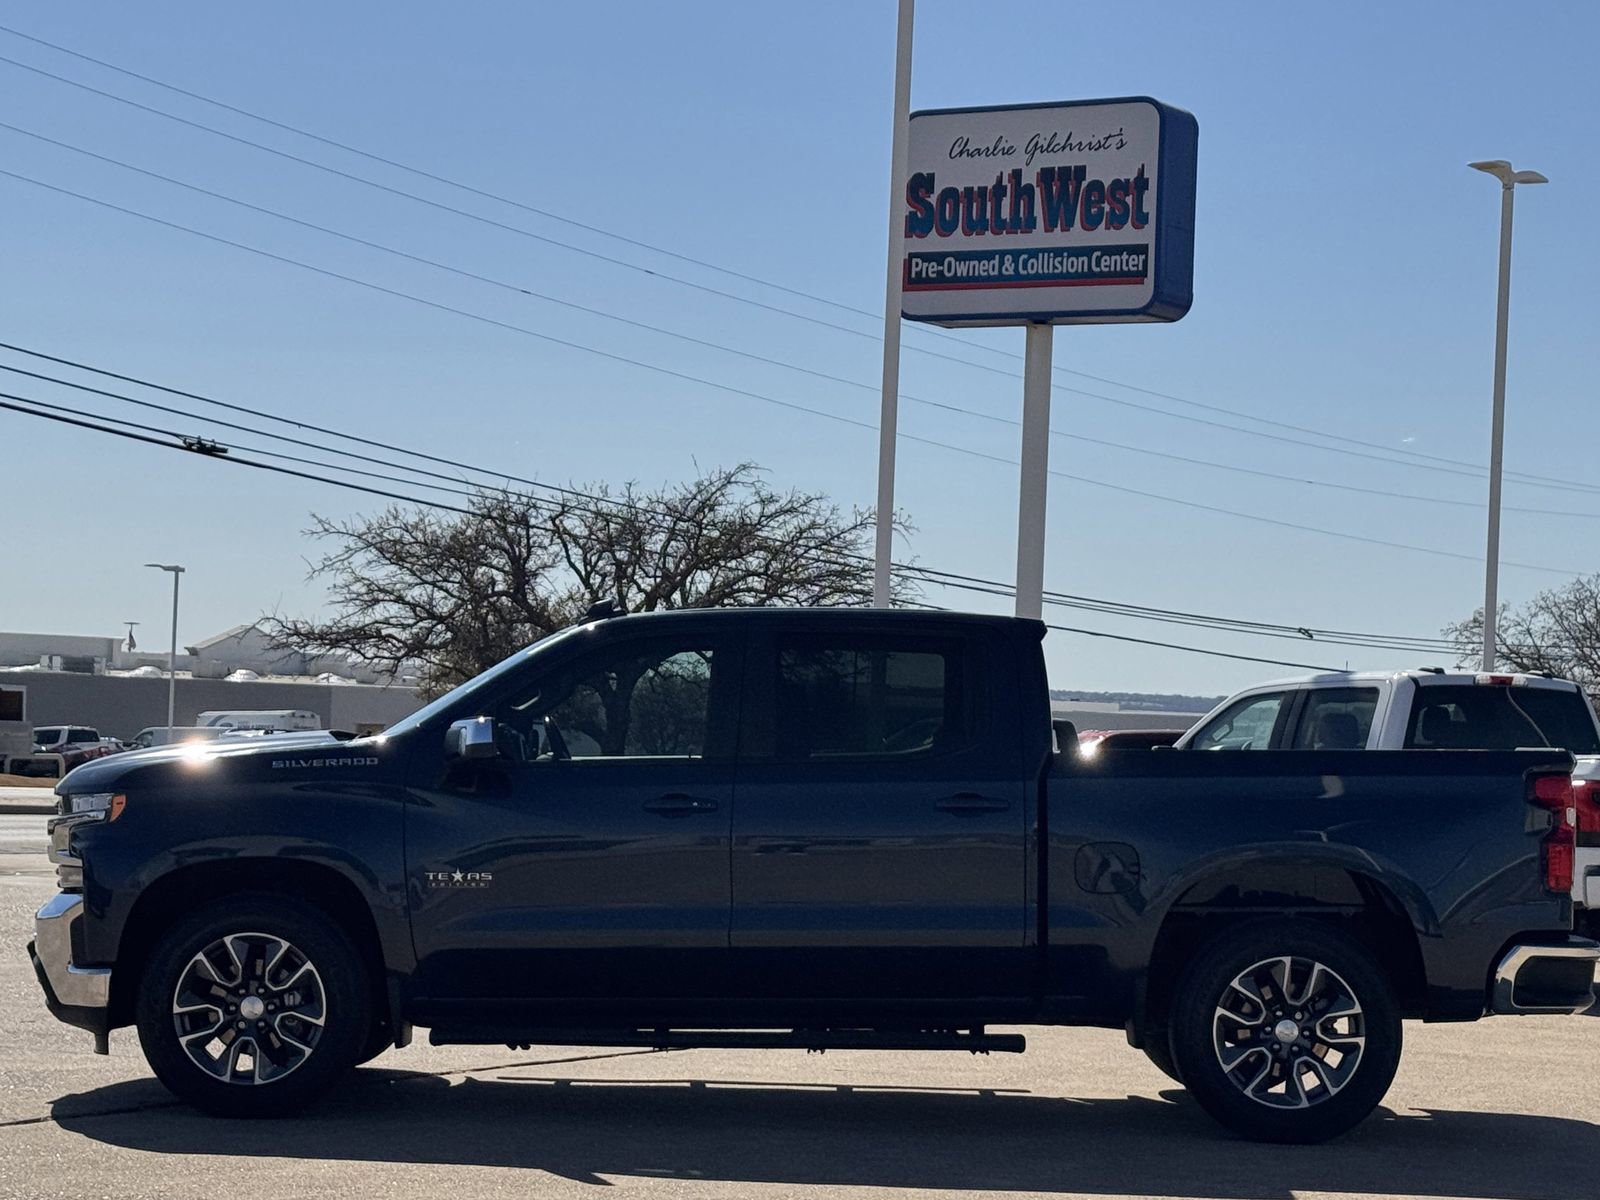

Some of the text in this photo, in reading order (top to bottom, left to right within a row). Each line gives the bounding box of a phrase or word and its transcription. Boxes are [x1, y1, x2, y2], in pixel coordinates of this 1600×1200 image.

[949, 127, 1128, 166] Charlie Gilchrist's
[904, 163, 1149, 239] SouthWest
[911, 251, 1146, 279] Pre-Owned & Collision Center
[271, 757, 379, 769] SILVERADO
[424, 867, 493, 882] TEXAS
